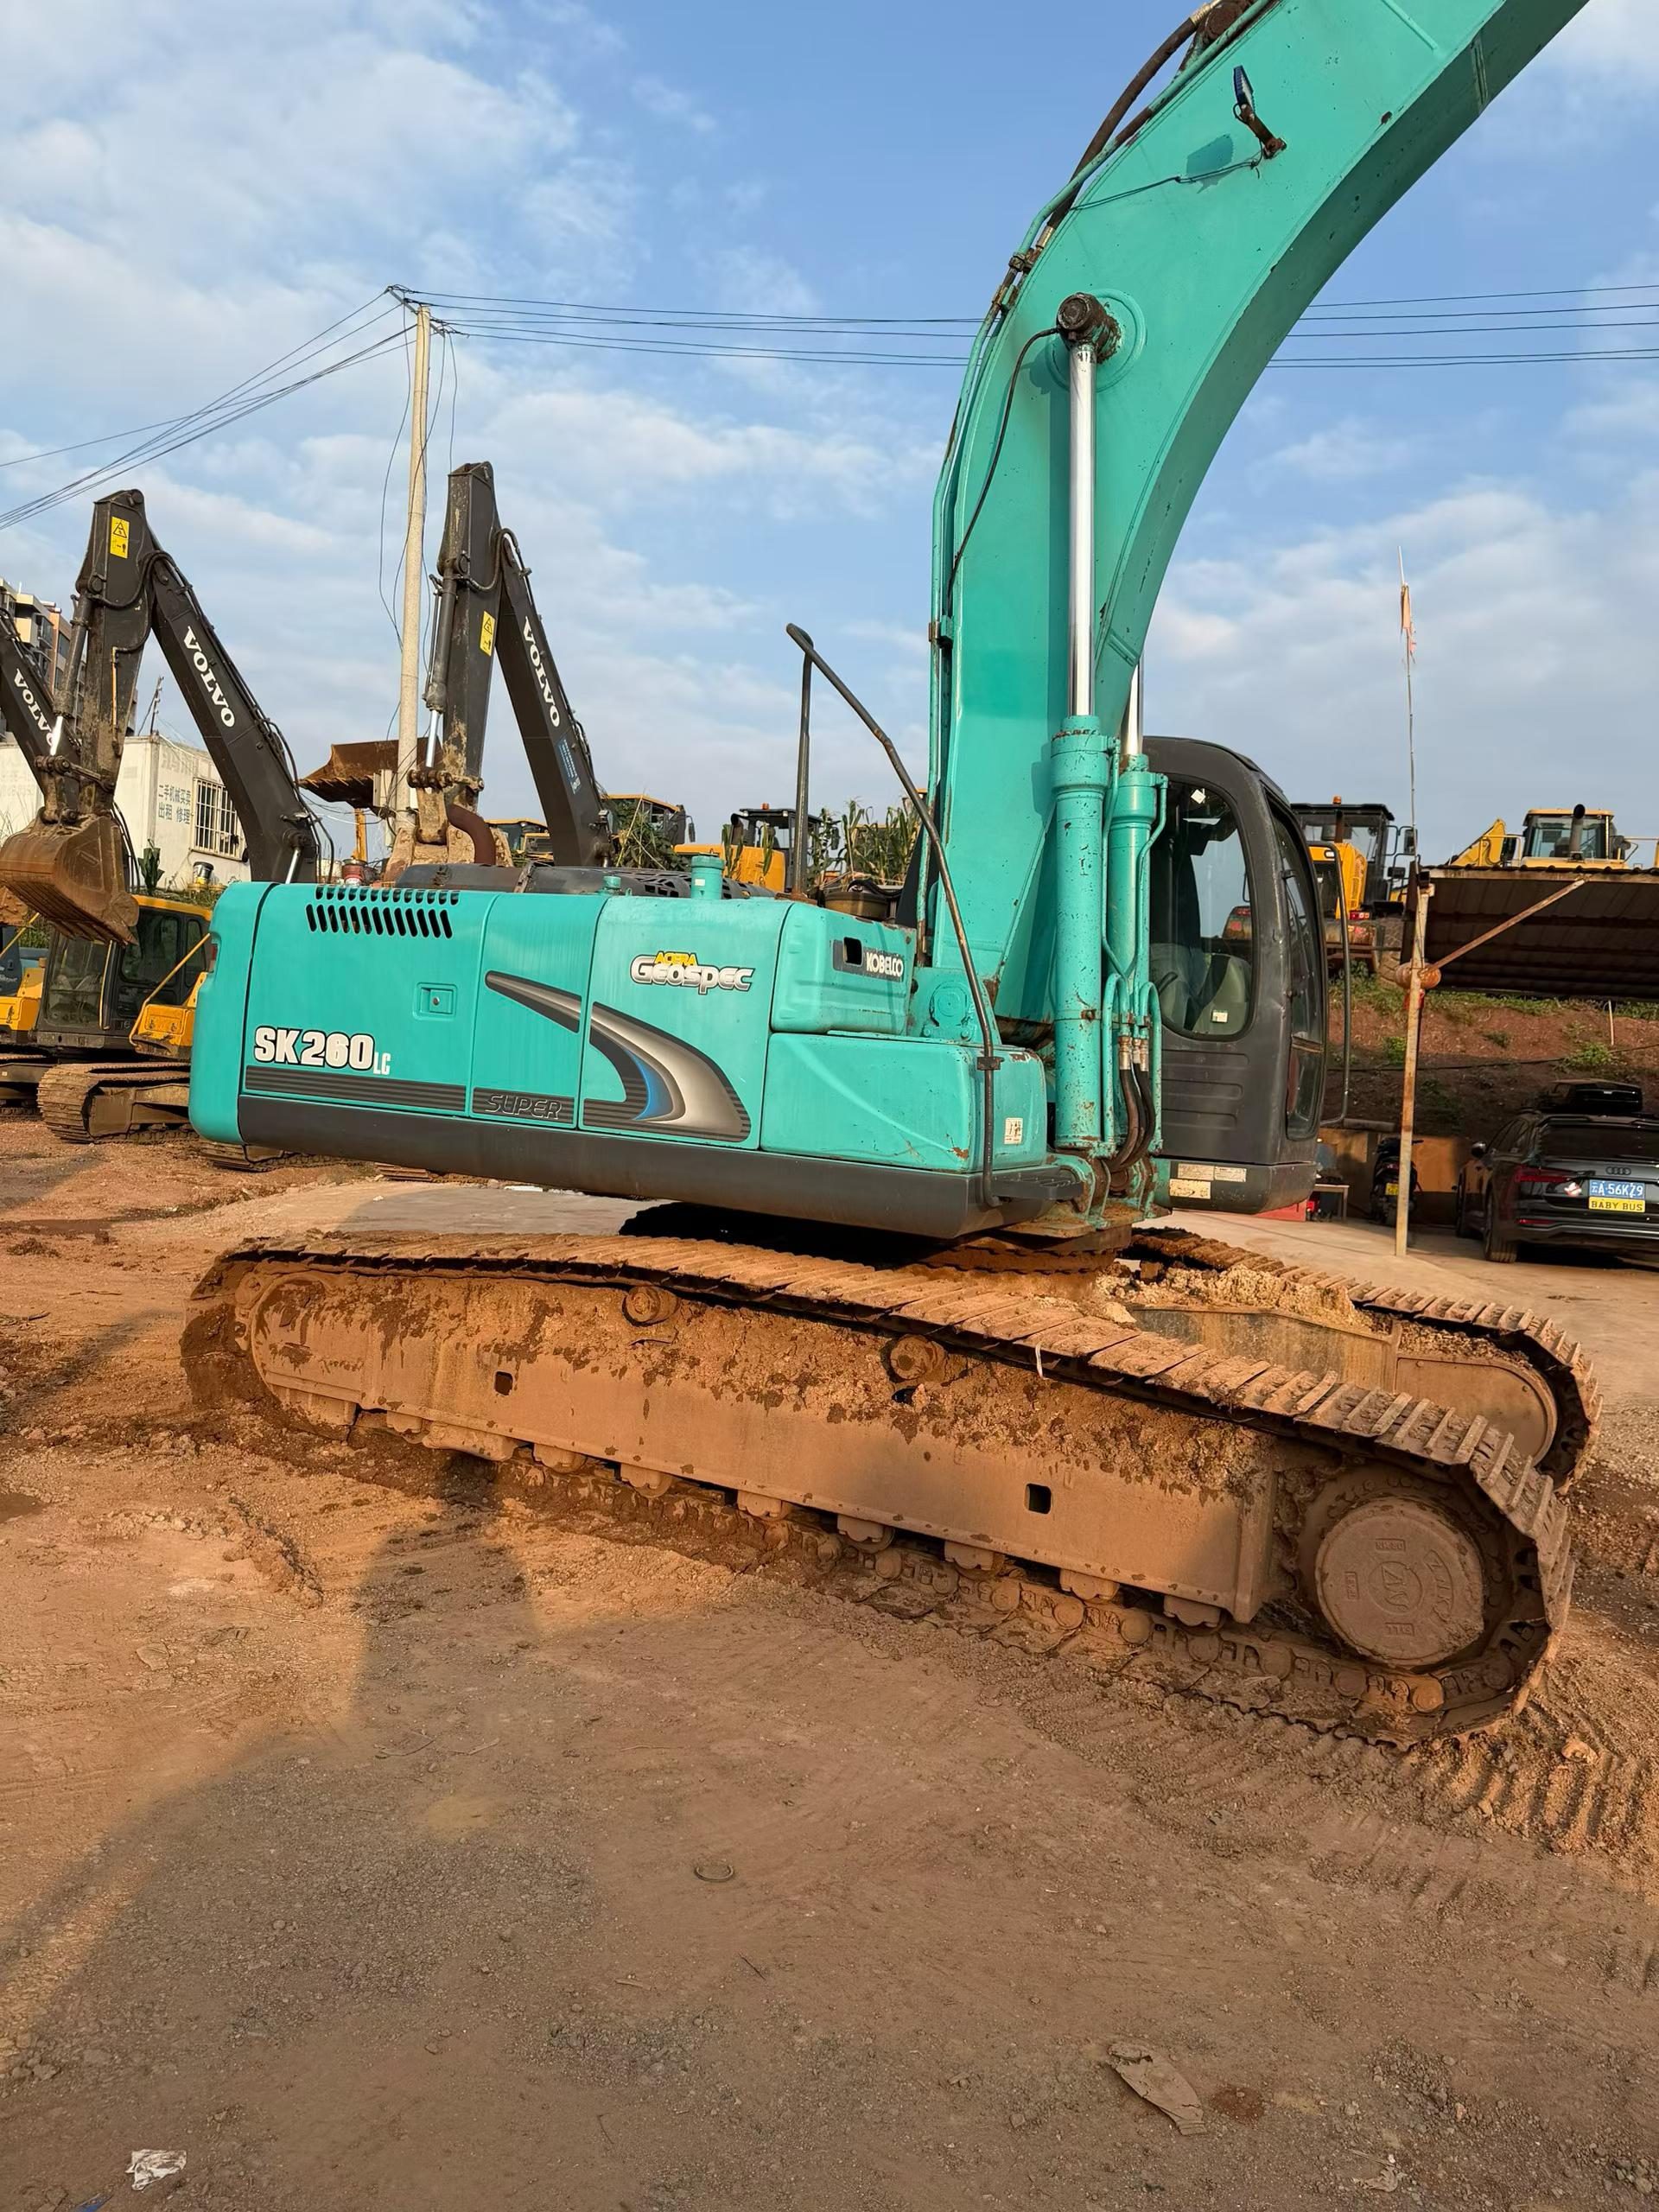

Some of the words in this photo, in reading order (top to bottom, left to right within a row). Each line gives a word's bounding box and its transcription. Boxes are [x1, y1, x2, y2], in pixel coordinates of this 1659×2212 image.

[184, 626, 235, 728] VOLVO
[523, 616, 560, 728] VOLVO
[654, 951, 699, 966] ACERA
[866, 951, 904, 977] KOBELCO
[485, 1095, 563, 1121] SUPER
[1591, 1200, 1618, 1210] BABY
[1622, 1203, 1643, 1211] BUS
